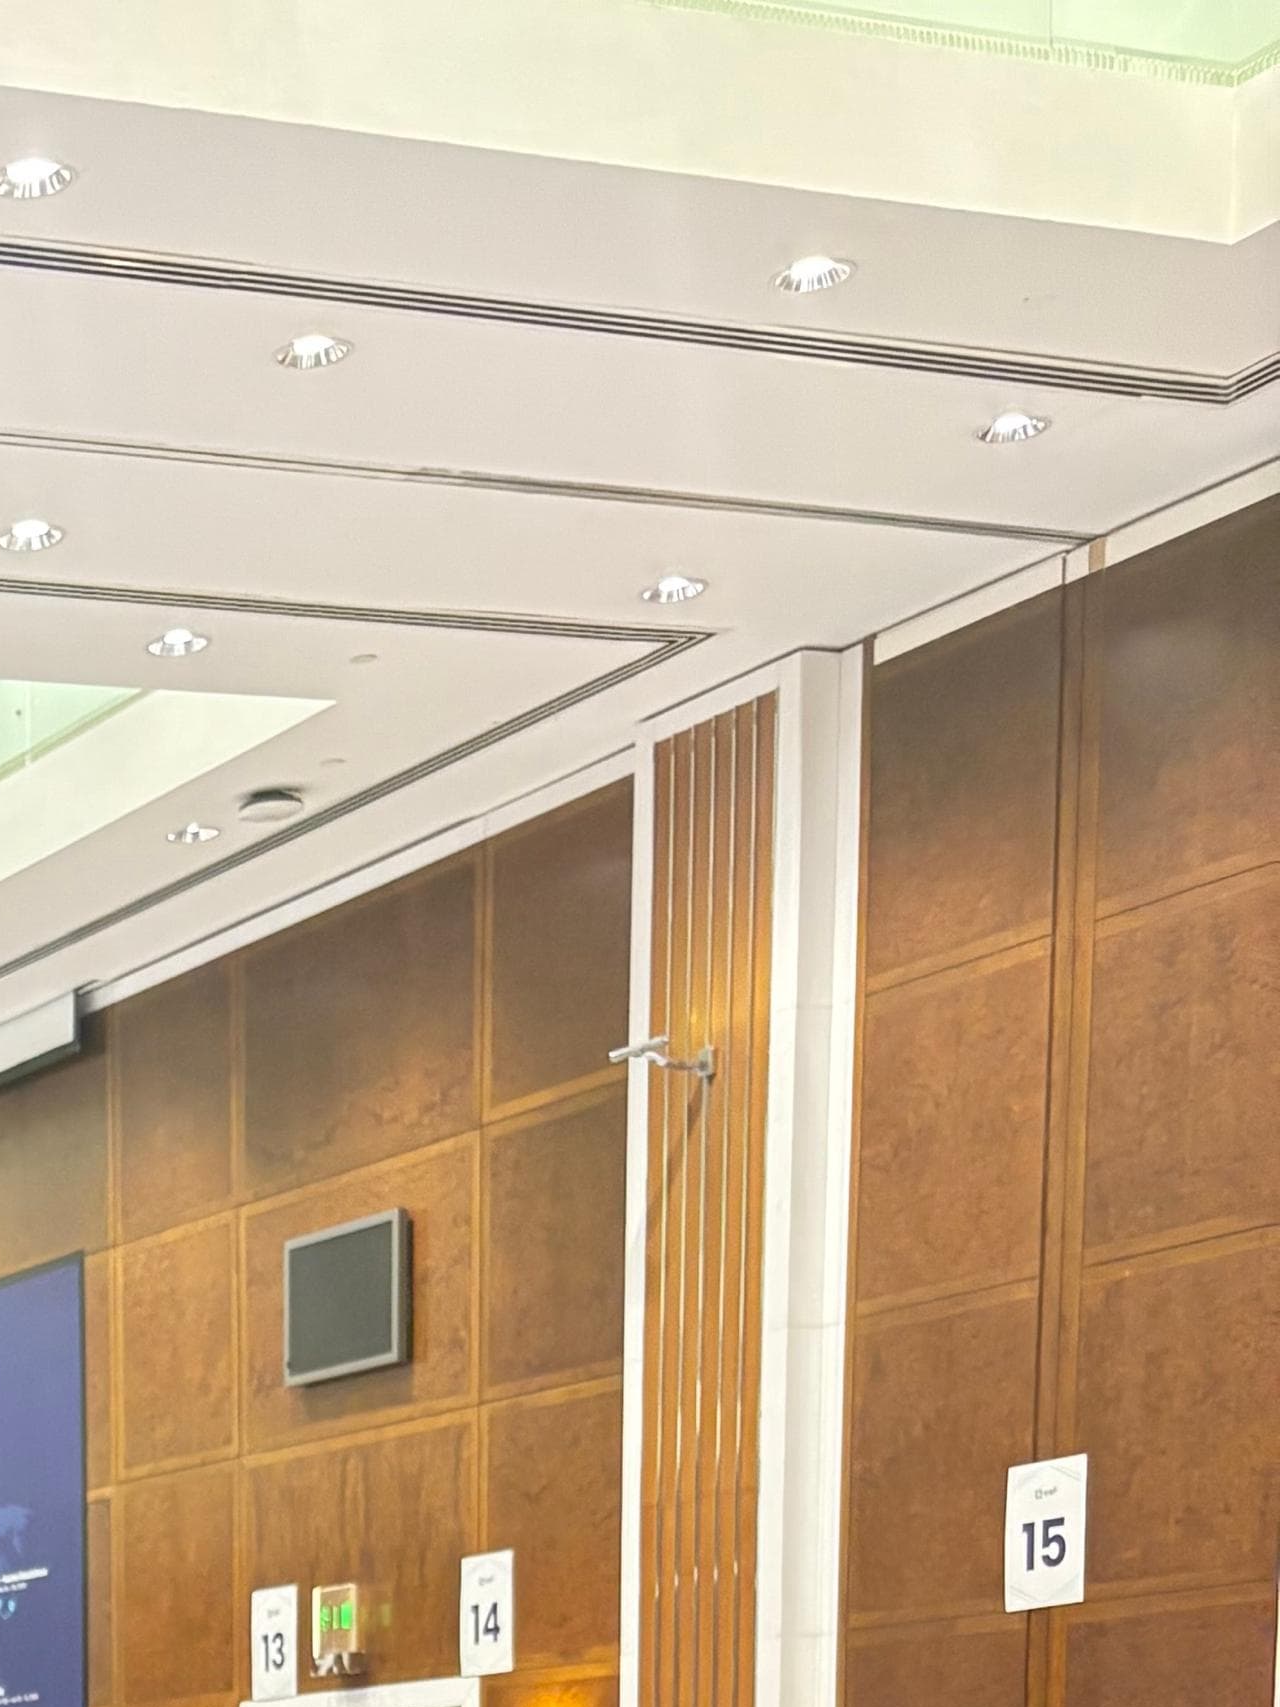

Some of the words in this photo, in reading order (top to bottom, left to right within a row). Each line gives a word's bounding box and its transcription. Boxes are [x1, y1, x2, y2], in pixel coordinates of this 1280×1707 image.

[1022, 1517, 1066, 1572] 15
[470, 1601, 501, 1646] 14
[261, 1632, 286, 1673] 13
